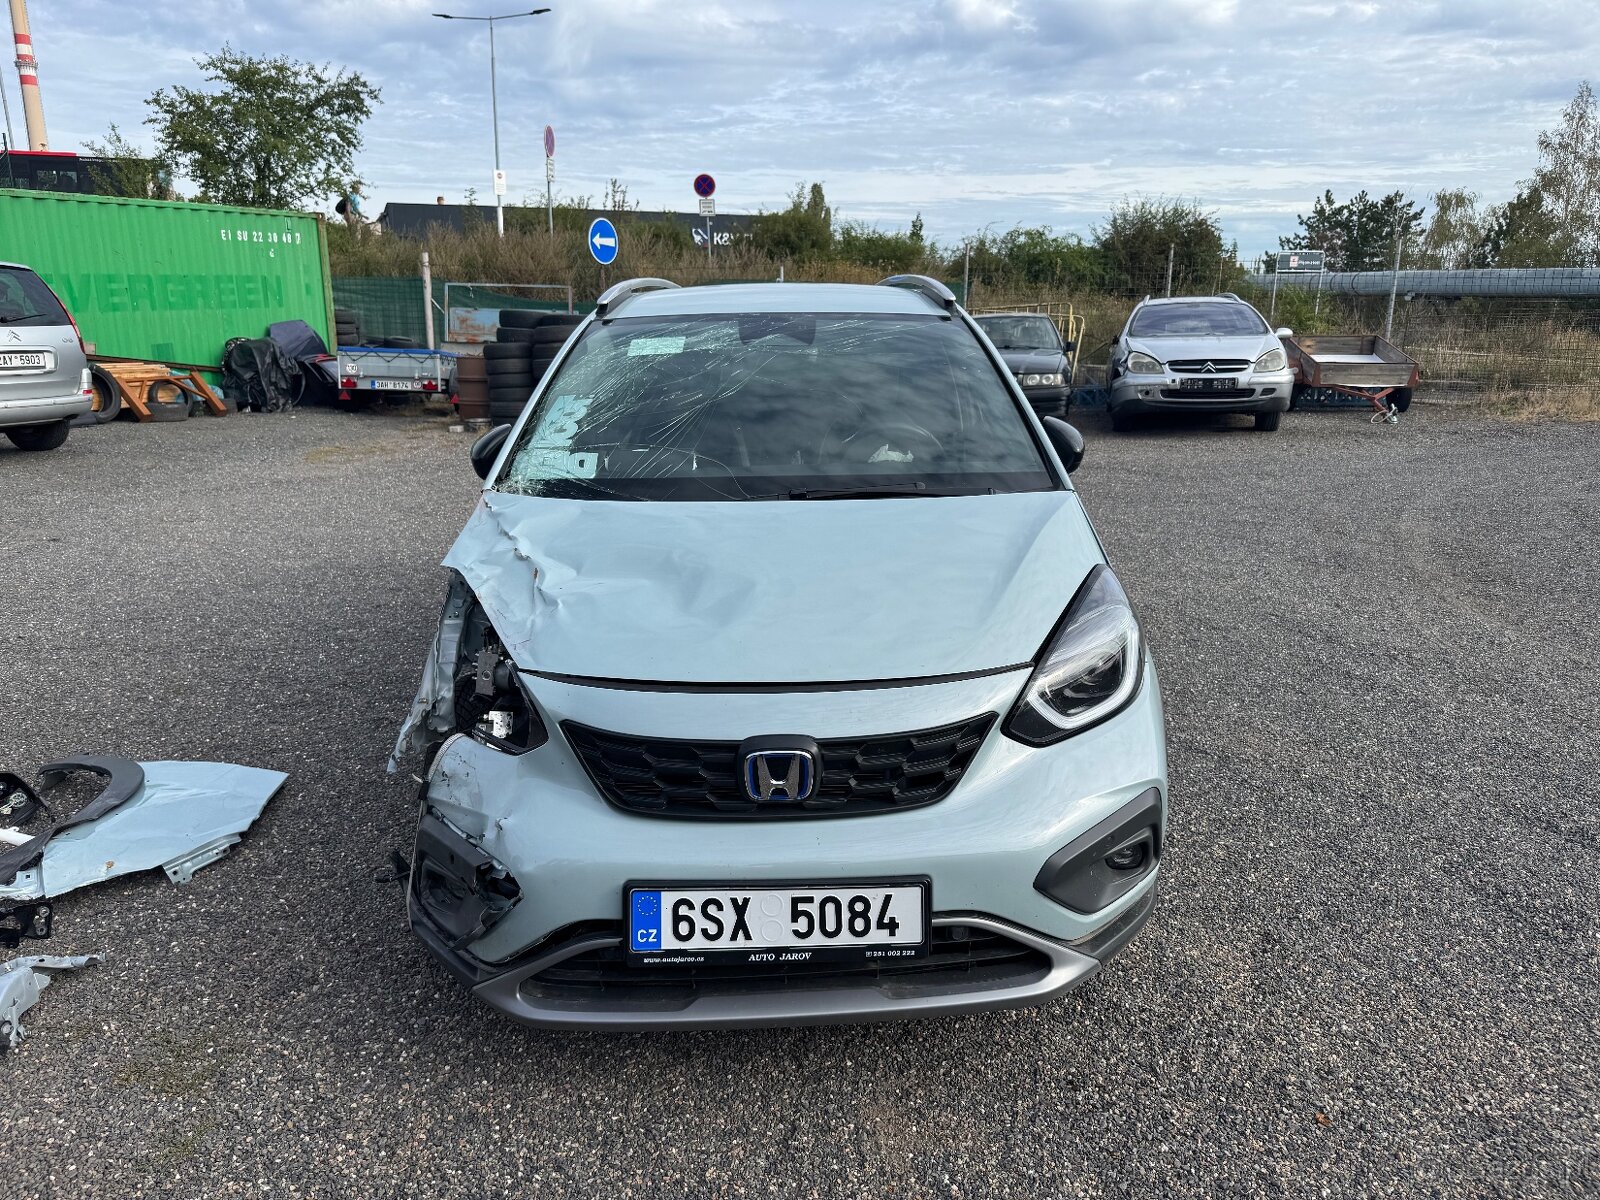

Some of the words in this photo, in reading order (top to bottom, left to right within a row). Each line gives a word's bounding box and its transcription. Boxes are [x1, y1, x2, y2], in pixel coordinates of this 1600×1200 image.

[40, 273, 284, 313] VERGREEN
[19, 354, 41, 365] 5903
[671, 896, 753, 942] 6SX
[790, 893, 900, 940] 5084
[637, 928, 658, 943] CZ
[748, 953, 776, 962] AUTO
[779, 952, 812, 961] JAROV
